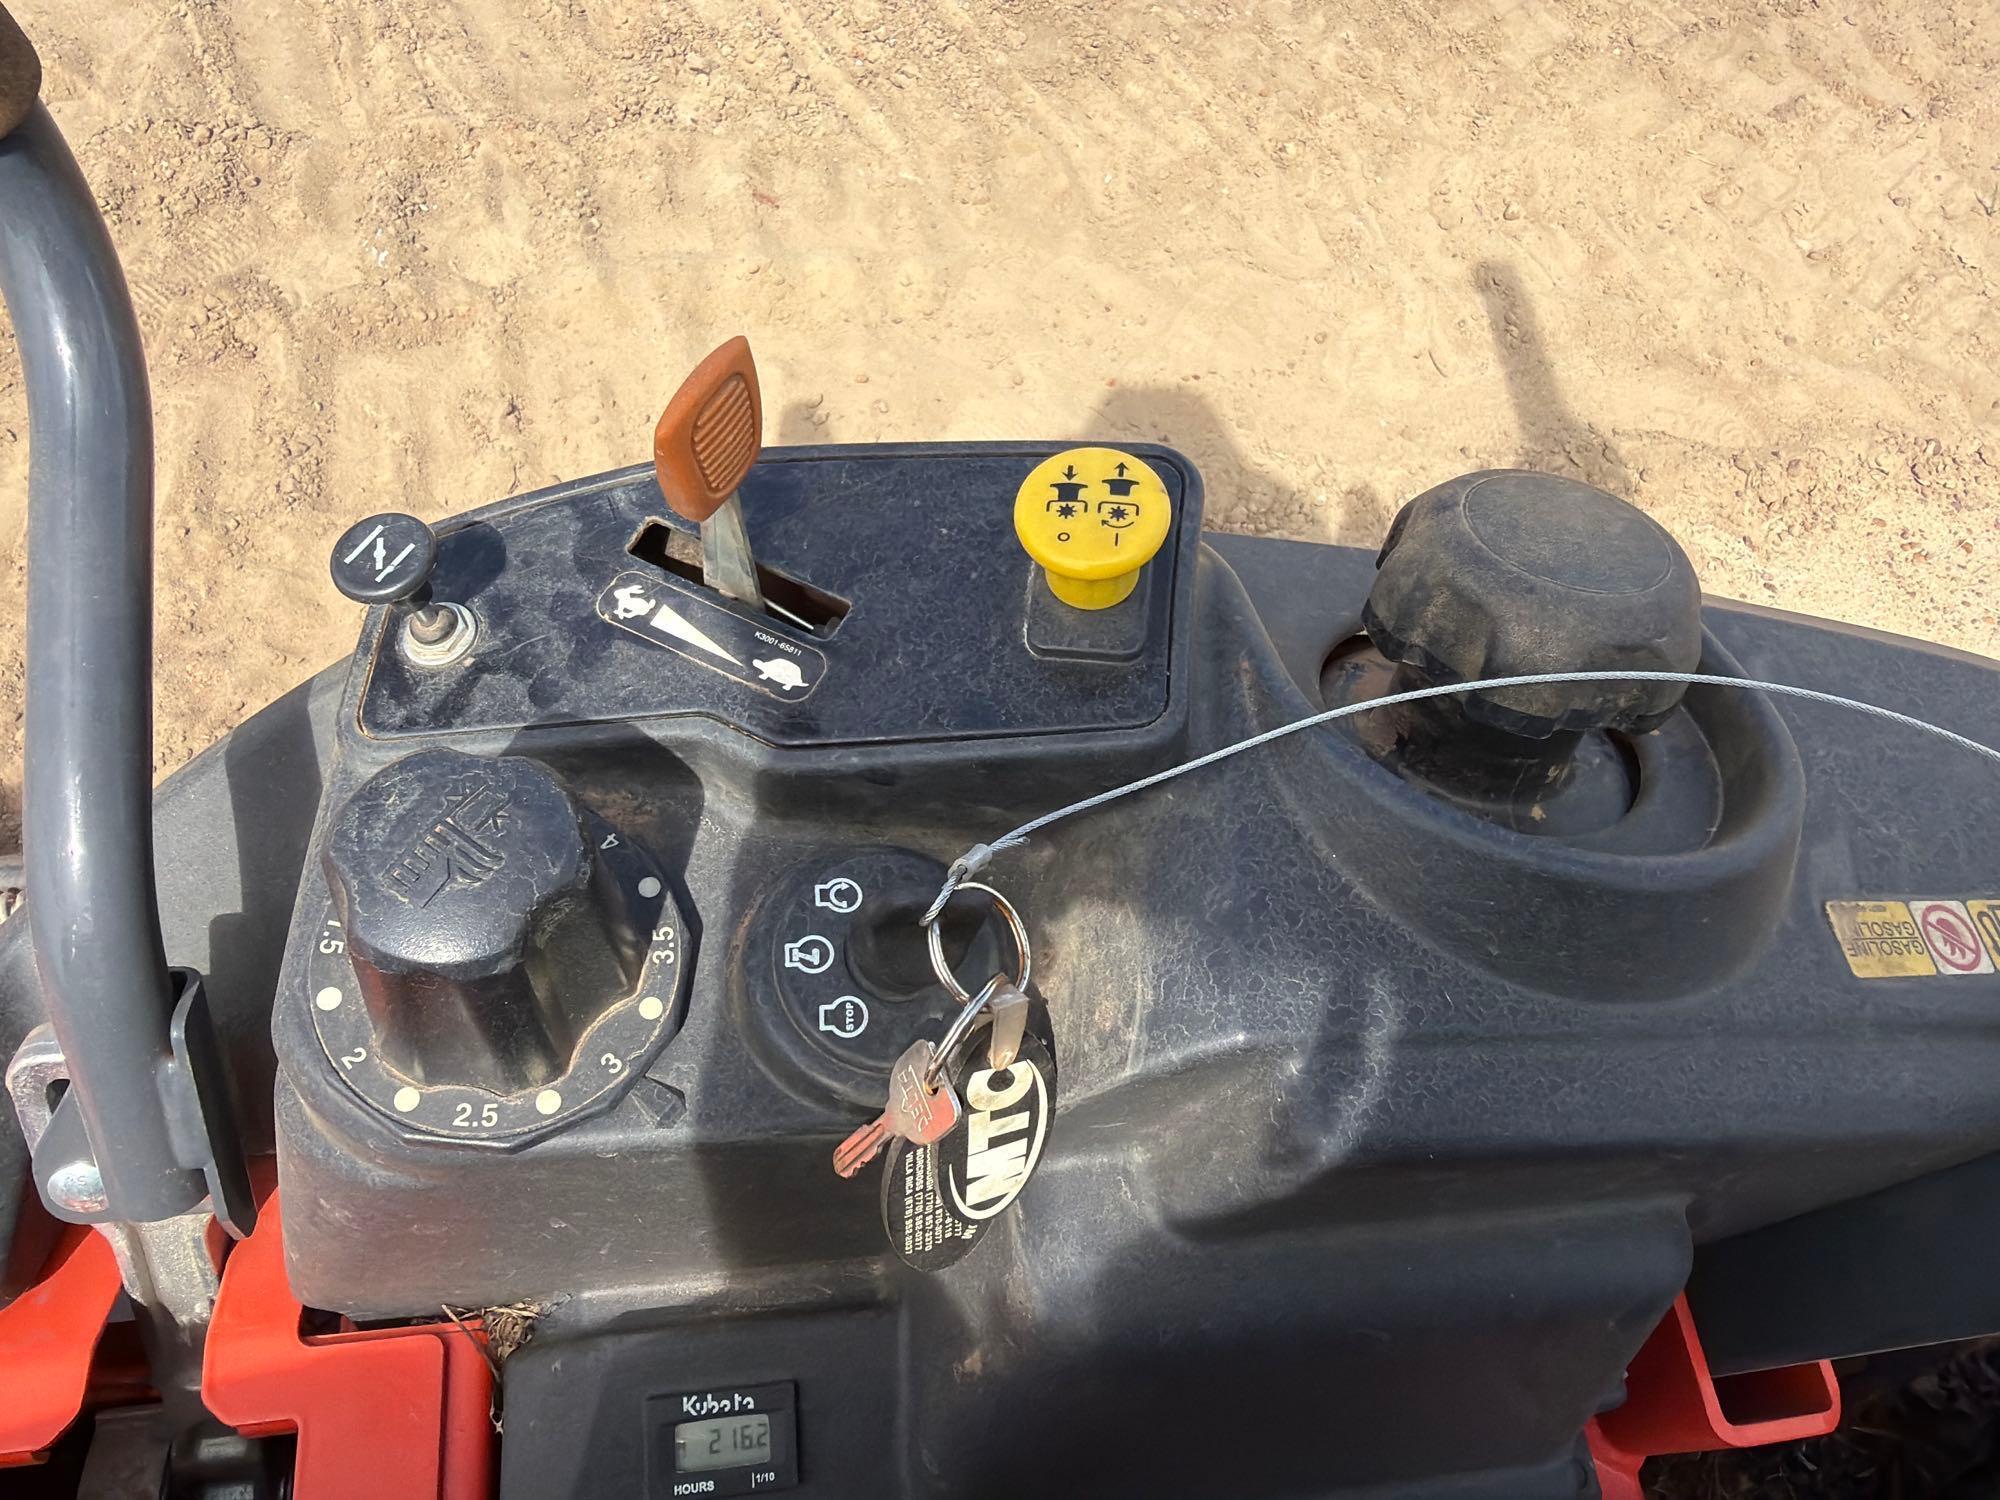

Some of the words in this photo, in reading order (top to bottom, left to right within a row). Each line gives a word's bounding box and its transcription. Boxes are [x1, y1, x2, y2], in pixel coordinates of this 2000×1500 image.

[754, 631, 802, 656] K3001-65811
[600, 832, 619, 850] 4
[320, 919, 345, 954] 1.5
[652, 926, 674, 965] 3.5
[846, 1002, 854, 1031] STOP
[340, 1046, 367, 1070] 2
[600, 1052, 623, 1074] 3
[452, 1102, 499, 1128] 2.5
[905, 1151, 913, 1175] VILLA
[915, 1147, 924, 1191] NORCROSS
[905, 1176, 913, 1195] RICA
[914, 1192, 924, 1214] (770)
[925, 1192, 933, 1214] (770)
[683, 1393, 755, 1416] Kubota
[674, 1480, 715, 1496] HOURS
[756, 1472, 775, 1483] 1/10
